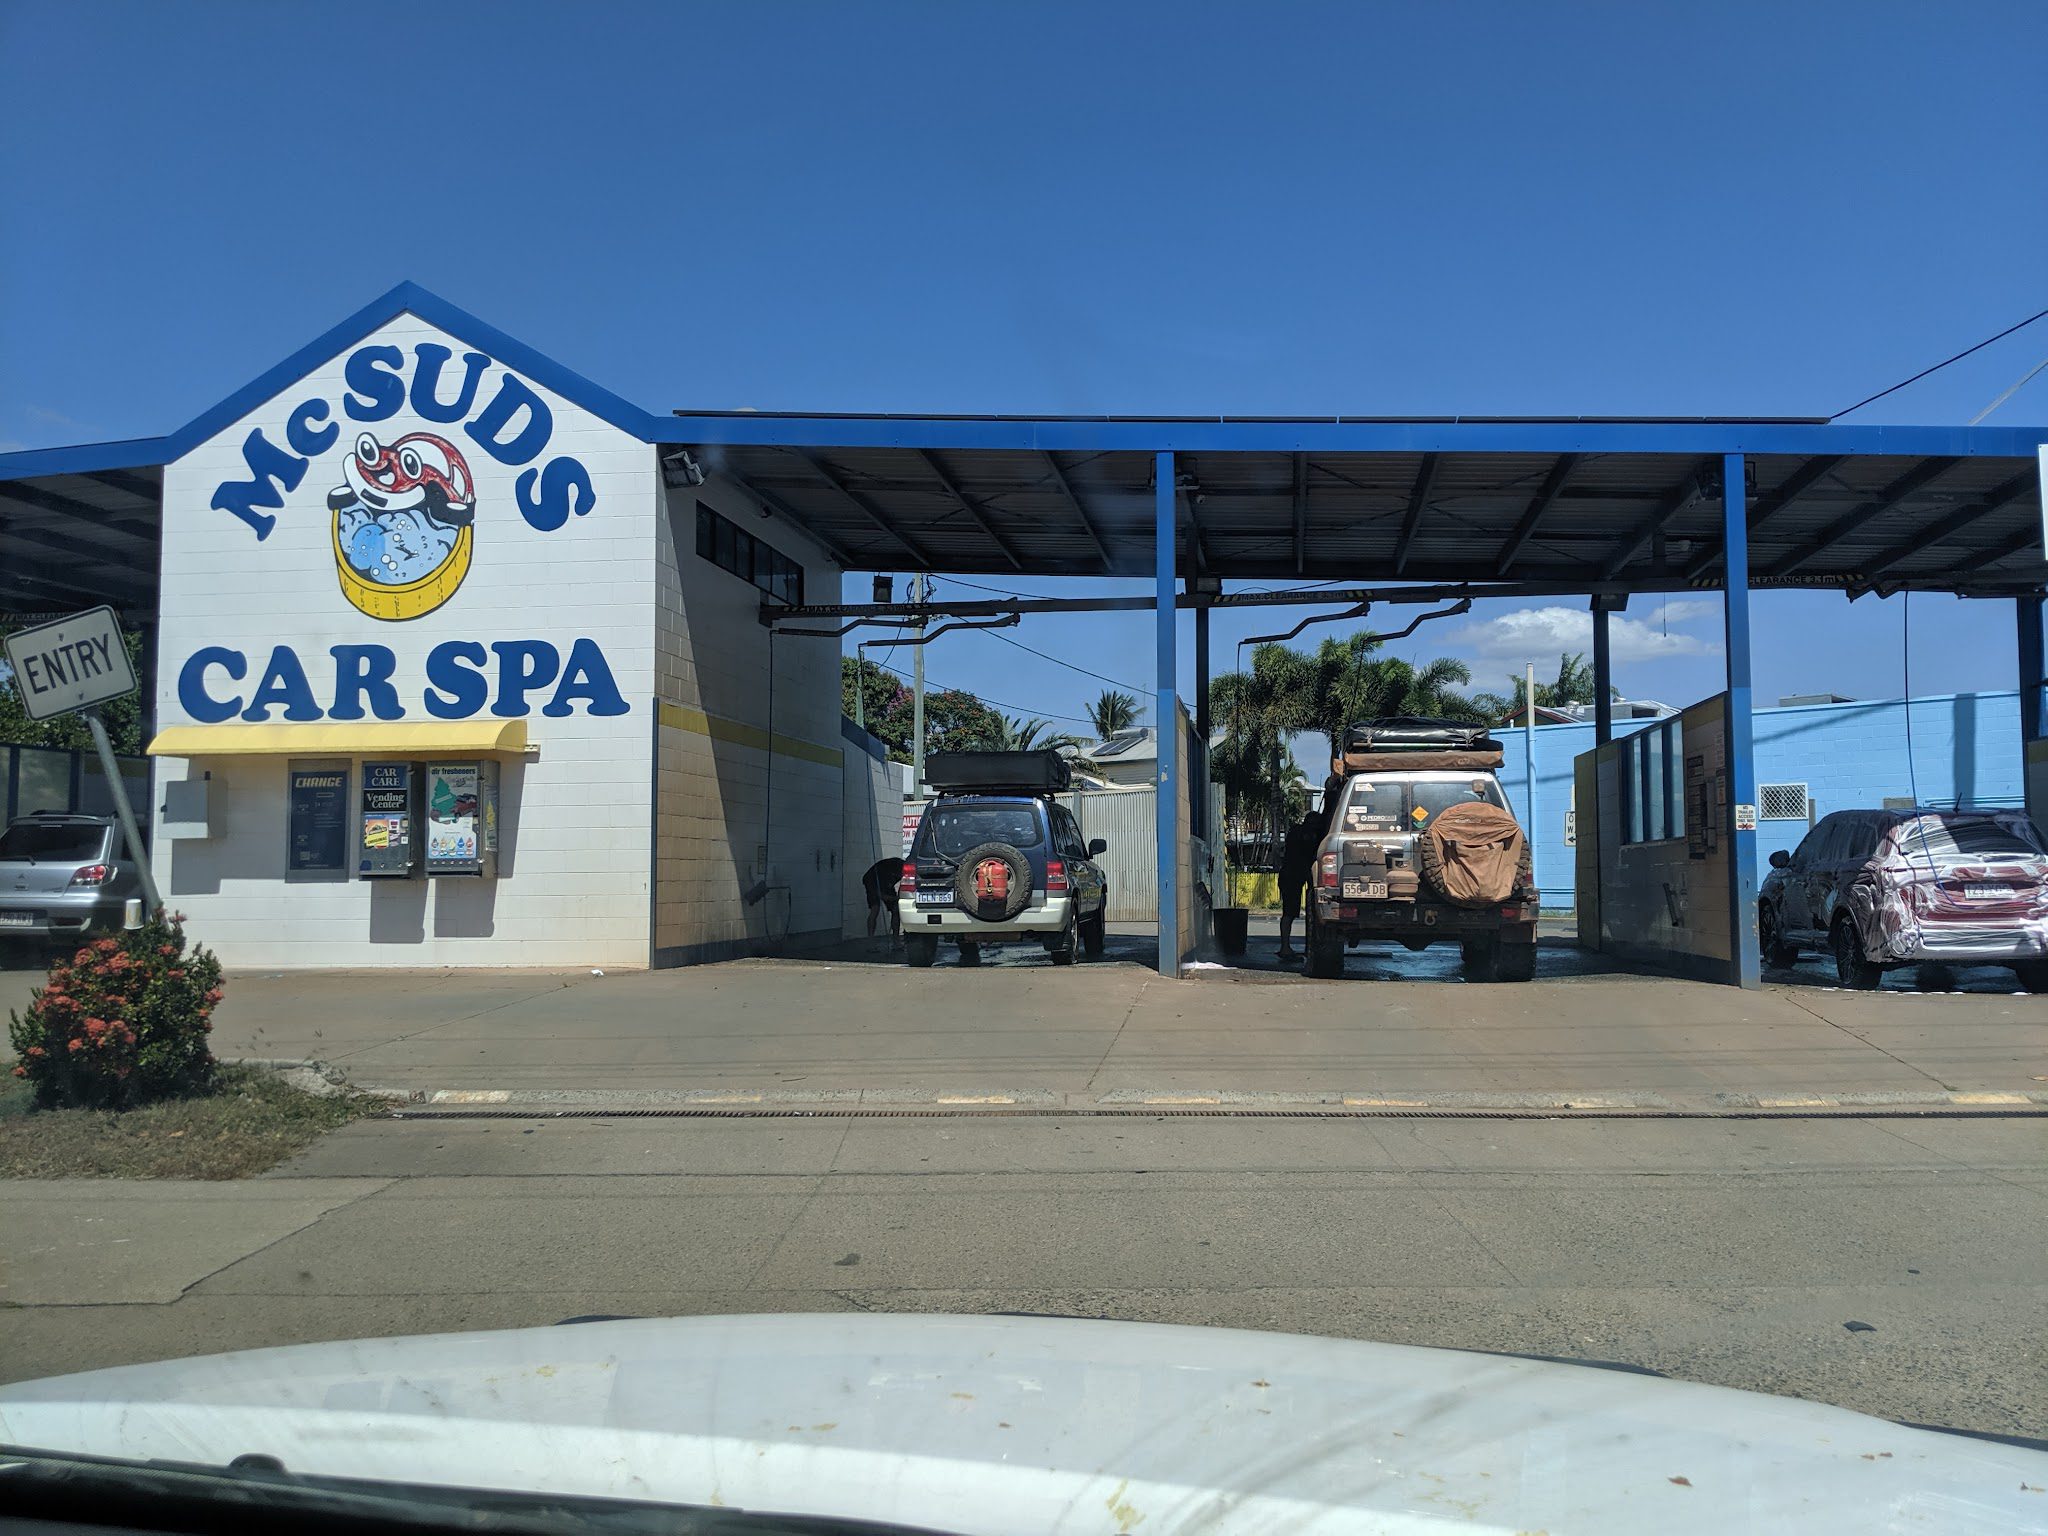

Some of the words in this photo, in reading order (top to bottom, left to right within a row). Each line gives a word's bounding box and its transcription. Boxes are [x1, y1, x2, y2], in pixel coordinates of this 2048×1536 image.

[23, 632, 113, 694] ENTRY
[178, 645, 406, 723] CAR
[423, 638, 631, 719] SPA
[375, 768, 397, 777] CAR
[295, 776, 343, 788] CHANGE
[371, 777, 400, 786] CARE
[366, 793, 405, 803] Vending
[372, 800, 401, 809] Center
